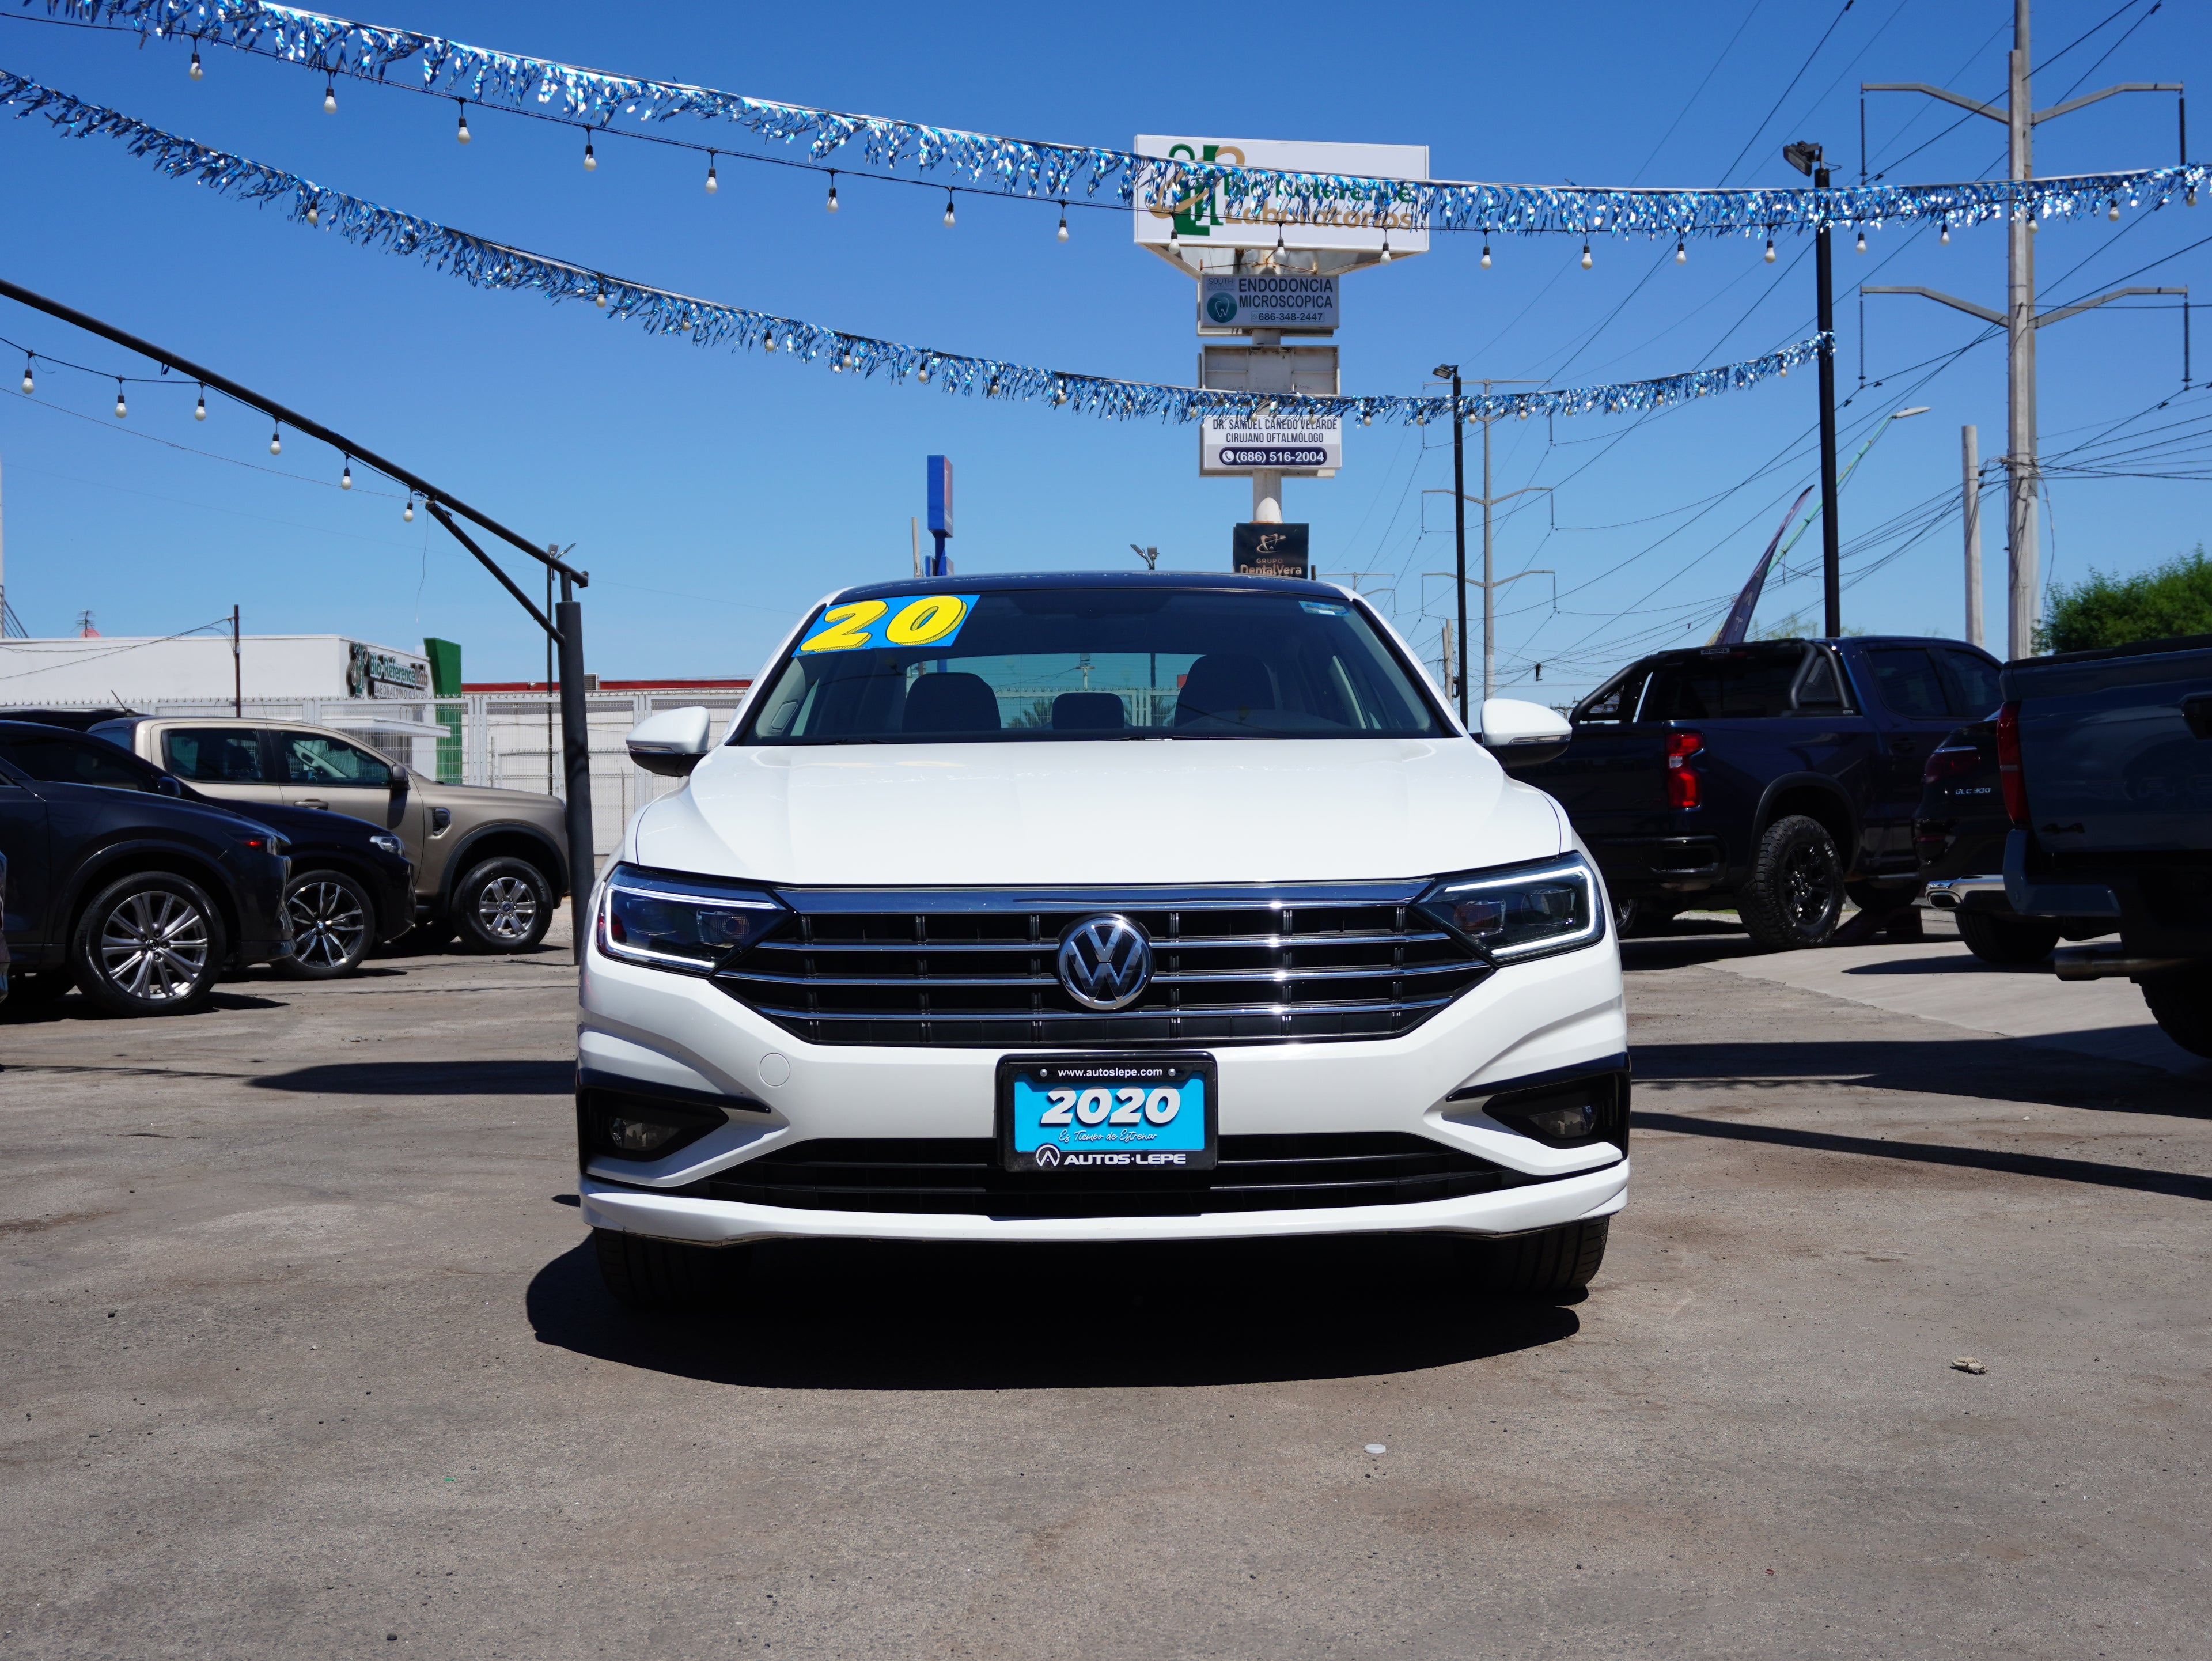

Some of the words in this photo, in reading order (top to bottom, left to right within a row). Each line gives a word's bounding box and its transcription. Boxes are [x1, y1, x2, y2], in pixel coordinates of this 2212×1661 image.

[1238, 278, 1333, 293] ENDODONCIA
[1239, 294, 1332, 308] MICROSCOPICA
[1258, 313, 1323, 321] 686-348-2447
[1213, 419, 1226, 430] DR.
[1229, 419, 1262, 430] SAMUEL
[1265, 418, 1298, 430] CAÑEDO
[1226, 432, 1264, 443] CIRUJANO
[1266, 430, 1324, 443] OFTALMÓLOGO
[1236, 451, 1266, 463] (686)
[1269, 451, 1324, 462] 516-2004
[1240, 564, 1302, 576] DentalVera
[800, 596, 968, 652] 20
[1057, 1068, 1163, 1079] www.autoslepe.com
[1040, 1086, 1181, 1124] 2020
[1059, 1129, 1070, 1142] Es
[1074, 1130, 1104, 1142] Tiempo
[1105, 1132, 1118, 1141] de
[1119, 1128, 1157, 1143] Estrenar
